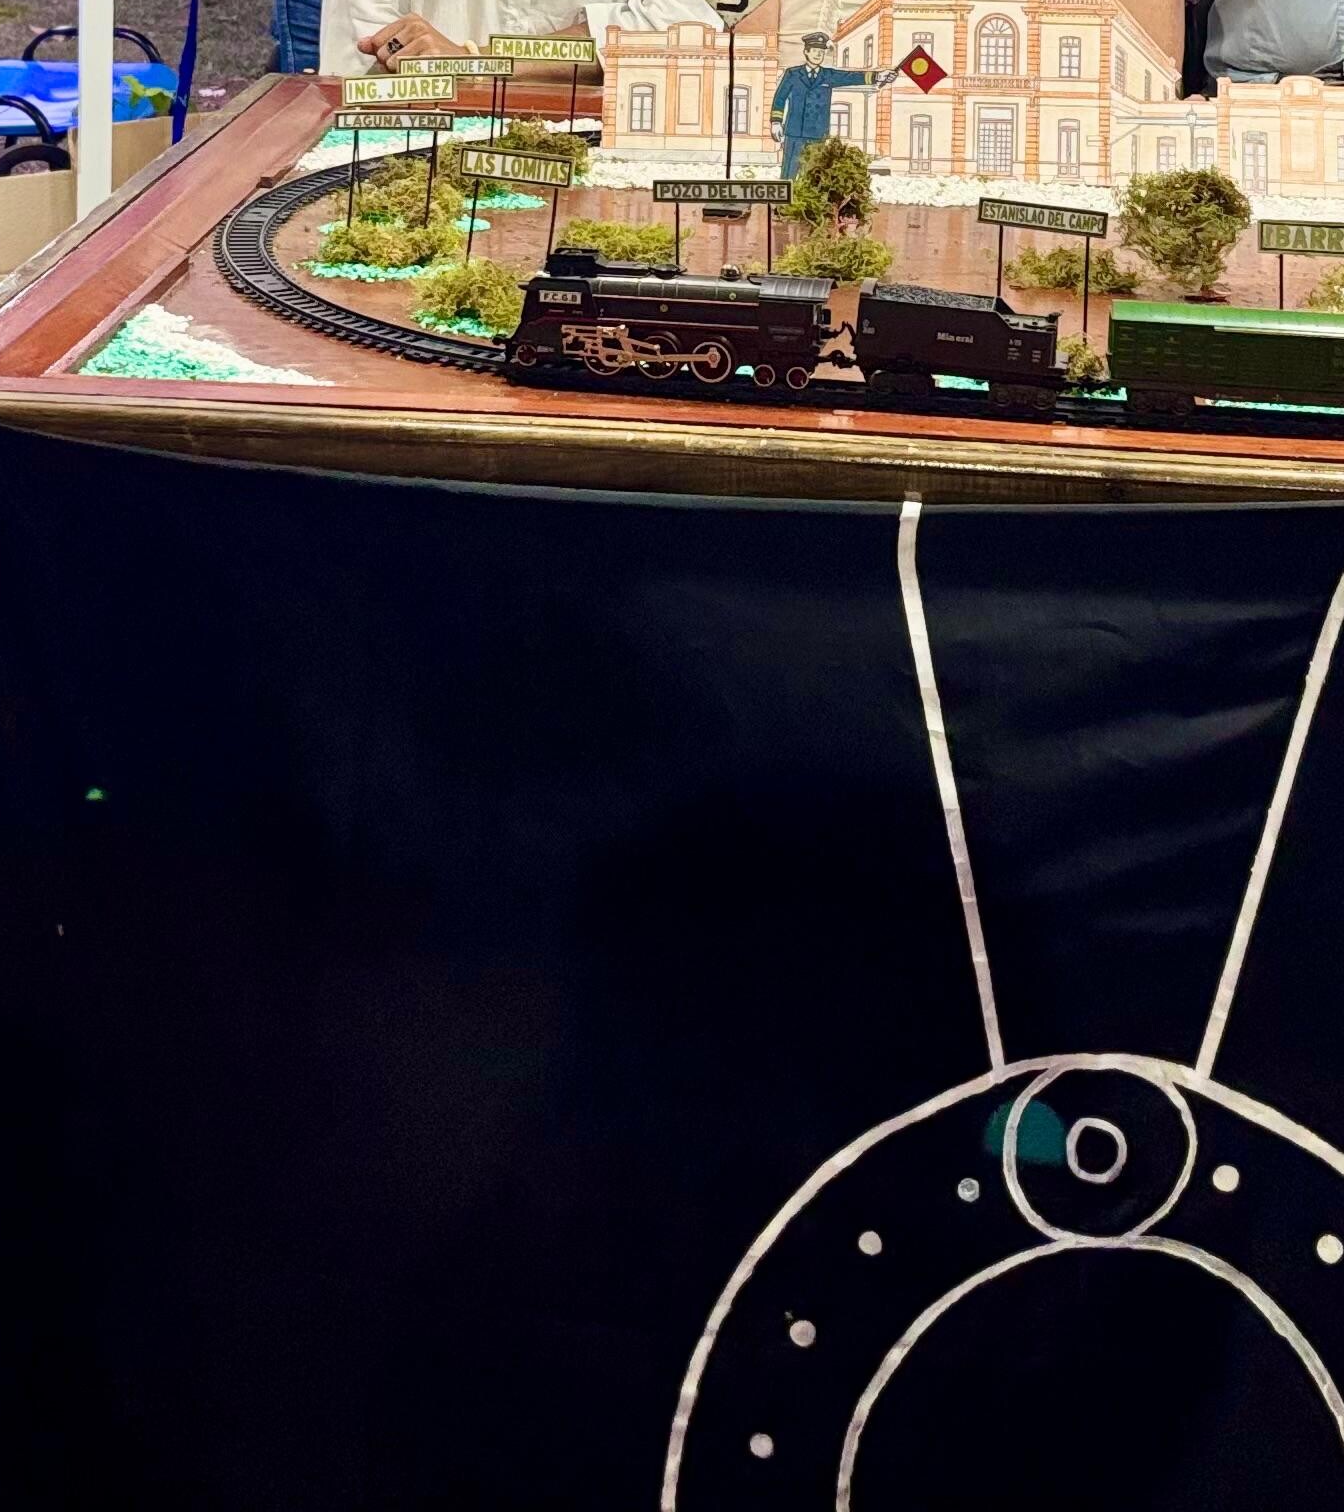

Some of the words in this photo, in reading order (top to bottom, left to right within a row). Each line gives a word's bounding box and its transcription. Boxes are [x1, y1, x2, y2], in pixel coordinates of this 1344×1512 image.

[402, 61, 423, 74] ING.
[427, 61, 475, 74] ENRIQUE
[478, 61, 510, 74] FAURE
[348, 82, 382, 100] ING.
[344, 115, 402, 127] LAGUNA
[408, 115, 448, 128] YEMA
[463, 151, 496, 175] LAS
[501, 155, 567, 183] LOMITAS
[660, 184, 703, 198] POZO
[708, 184, 737, 199] DEL
[743, 185, 786, 200] TIGRE
[983, 202, 1045, 224] ESTANISLAO
[1048, 210, 1066, 227] DEL
[1069, 214, 1104, 233] CAMPO
